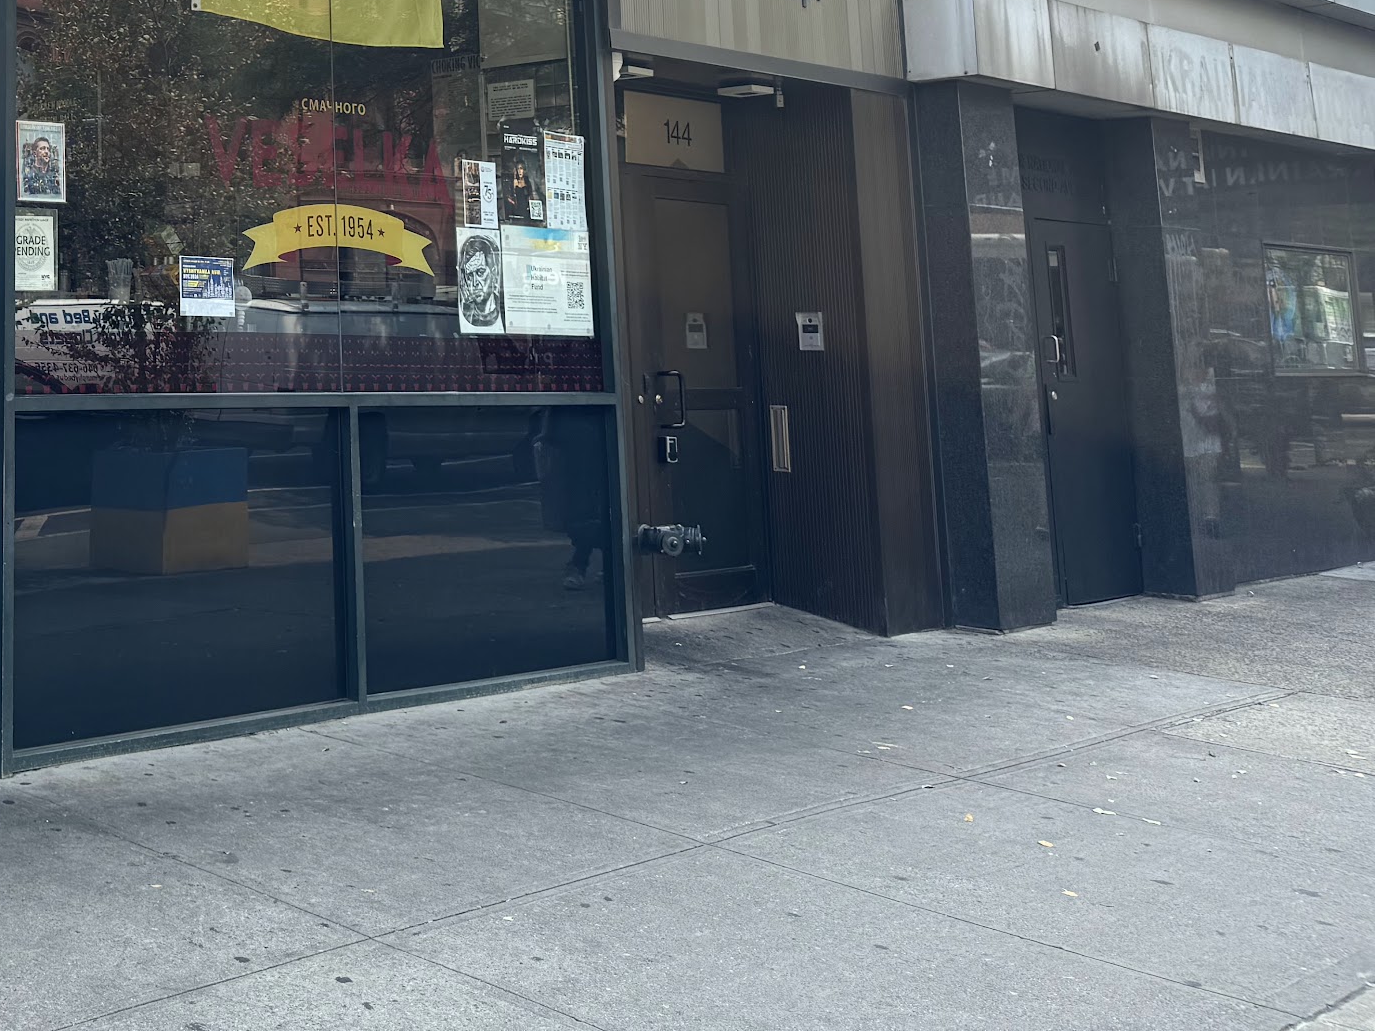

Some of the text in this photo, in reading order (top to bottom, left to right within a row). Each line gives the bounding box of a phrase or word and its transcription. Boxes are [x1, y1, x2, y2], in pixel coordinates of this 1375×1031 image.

[301, 97, 366, 116] СМАЧНОГО
[663, 119, 692, 147] 144
[504, 136, 538, 146] HARDKISS
[307, 215, 374, 240] EST. 1954
[16, 235, 46, 245] GRADE
[15, 247, 51, 257] ENDING
[530, 265, 553, 273] Ukrainian
